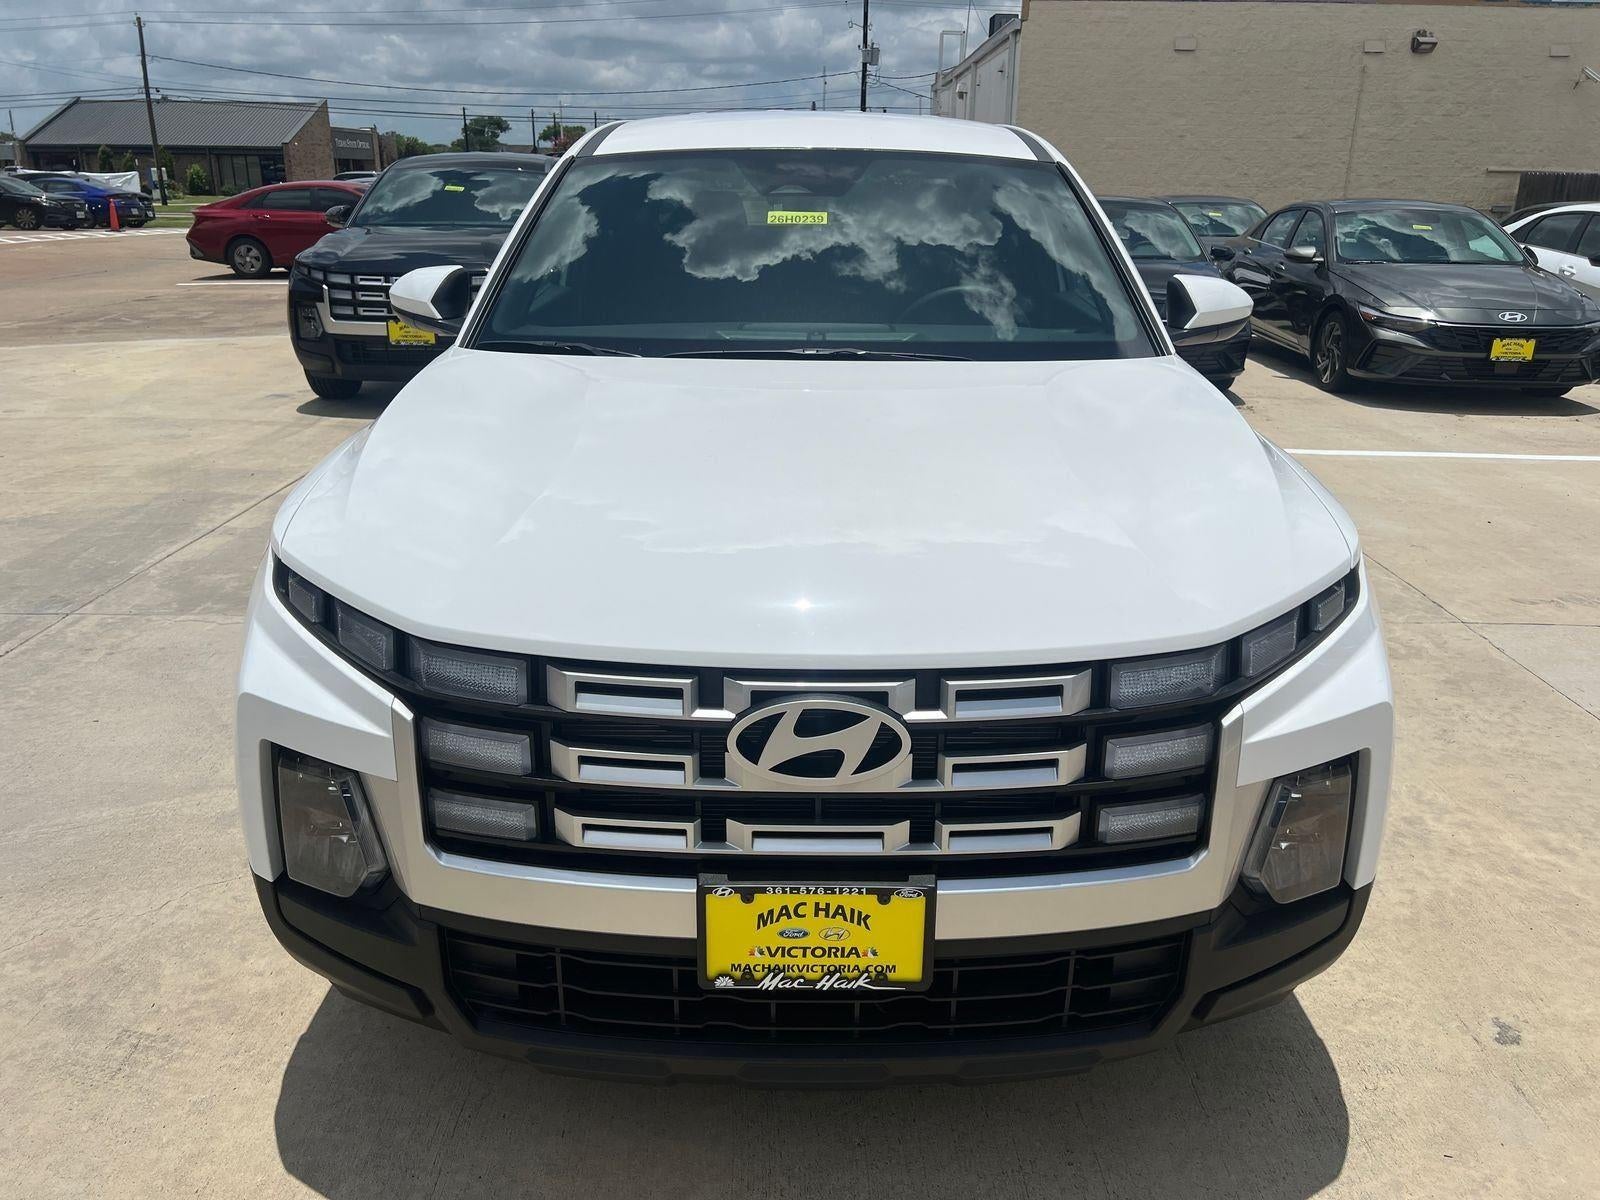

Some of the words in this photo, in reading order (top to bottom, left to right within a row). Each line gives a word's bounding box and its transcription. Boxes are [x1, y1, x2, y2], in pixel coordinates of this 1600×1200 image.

[770, 215, 824, 223] 26H0239
[765, 887, 867, 895] 361-576-1221
[756, 902, 808, 931] MAC
[813, 902, 872, 931] HAIK
[765, 945, 862, 959] VICTORIA
[730, 963, 897, 974] MACHAIKVICTORIA.COM
[757, 972, 806, 991] Mac
[815, 972, 873, 991] Haik
